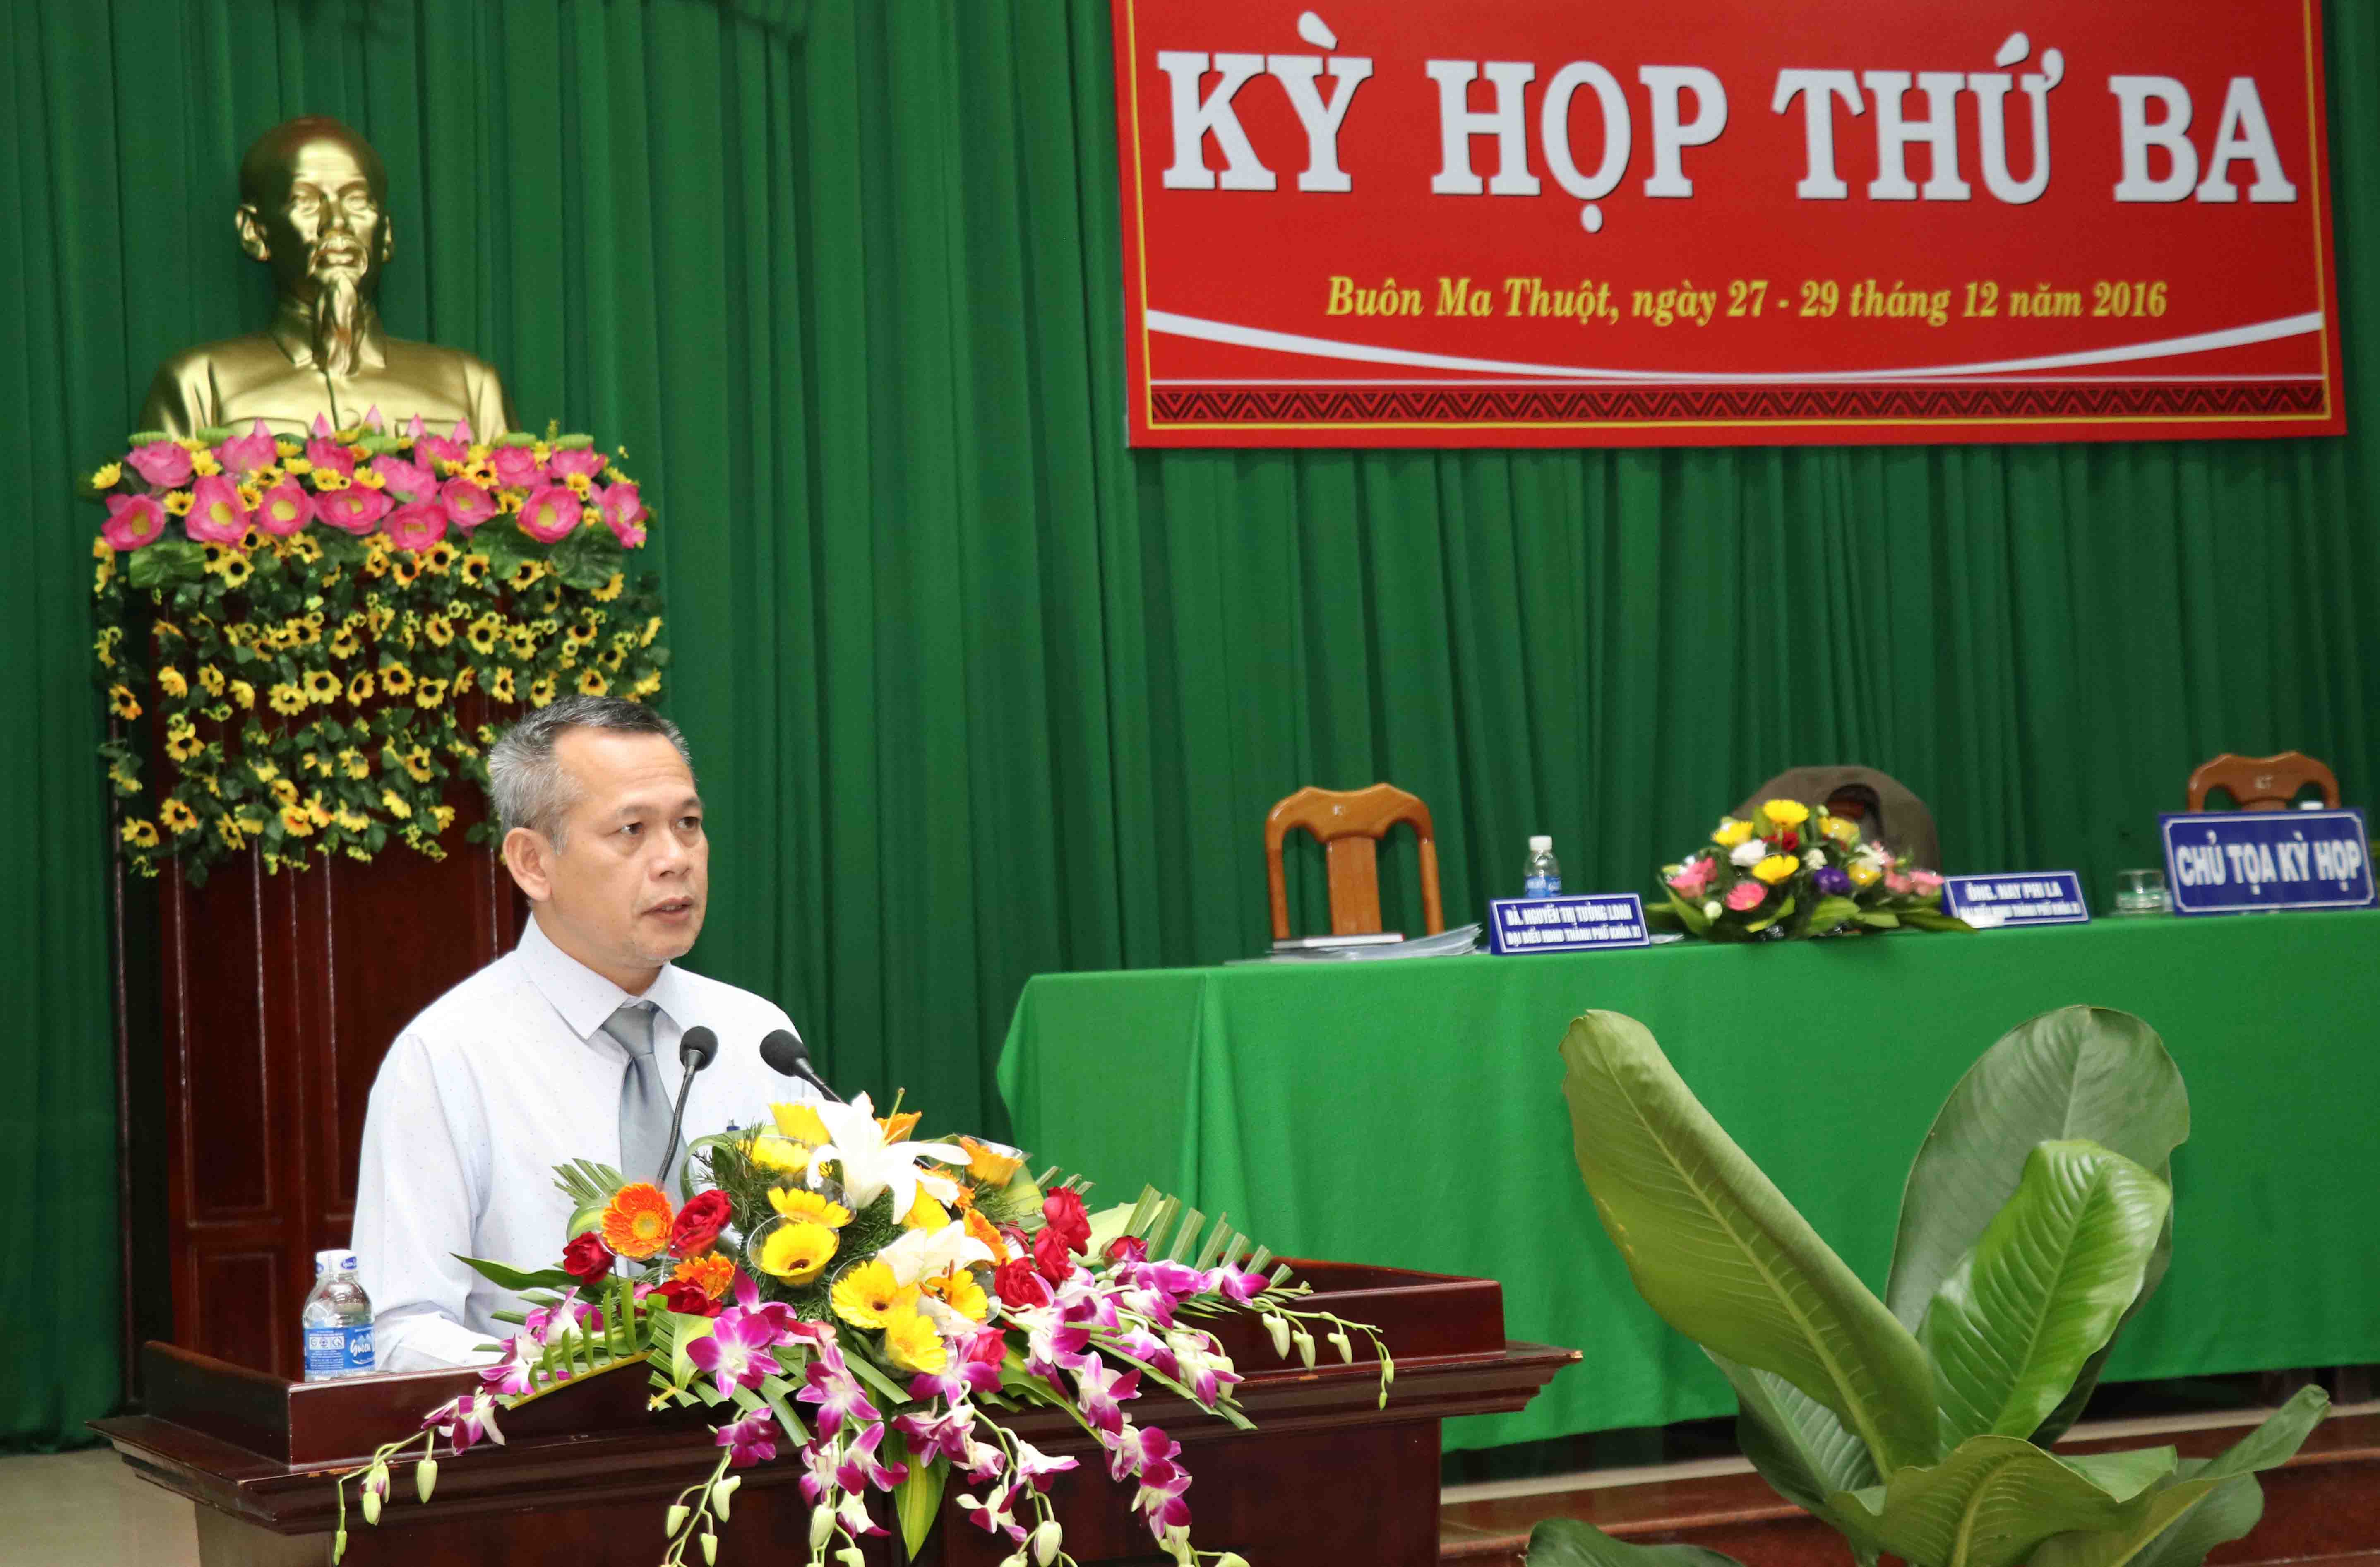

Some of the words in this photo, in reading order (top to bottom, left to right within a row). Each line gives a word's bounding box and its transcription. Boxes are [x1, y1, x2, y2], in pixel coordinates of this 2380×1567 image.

[1156, 10, 1373, 192] KỲ
[1425, 59, 1728, 233] HỌP
[1771, 31, 2065, 204] THỨ
[2108, 75, 2296, 202] BA
[1326, 275, 1424, 317] Buôn
[1435, 277, 1494, 317] Ma
[1504, 278, 1619, 325] Thuột,
[1632, 279, 1717, 327] ngày
[1727, 280, 1768, 317] 27
[1778, 299, 1789, 308] -
[1800, 280, 1839, 317] 29
[1850, 279, 1951, 327] tháng
[1963, 281, 1998, 317] 12
[2009, 284, 2082, 317] năm
[2092, 281, 2167, 317] 2016
[2176, 829, 2226, 886] CHỦ
[2227, 842, 2277, 895] TỌA
[2277, 830, 2310, 882] KỲ
[2313, 839, 2362, 892] HỌP
